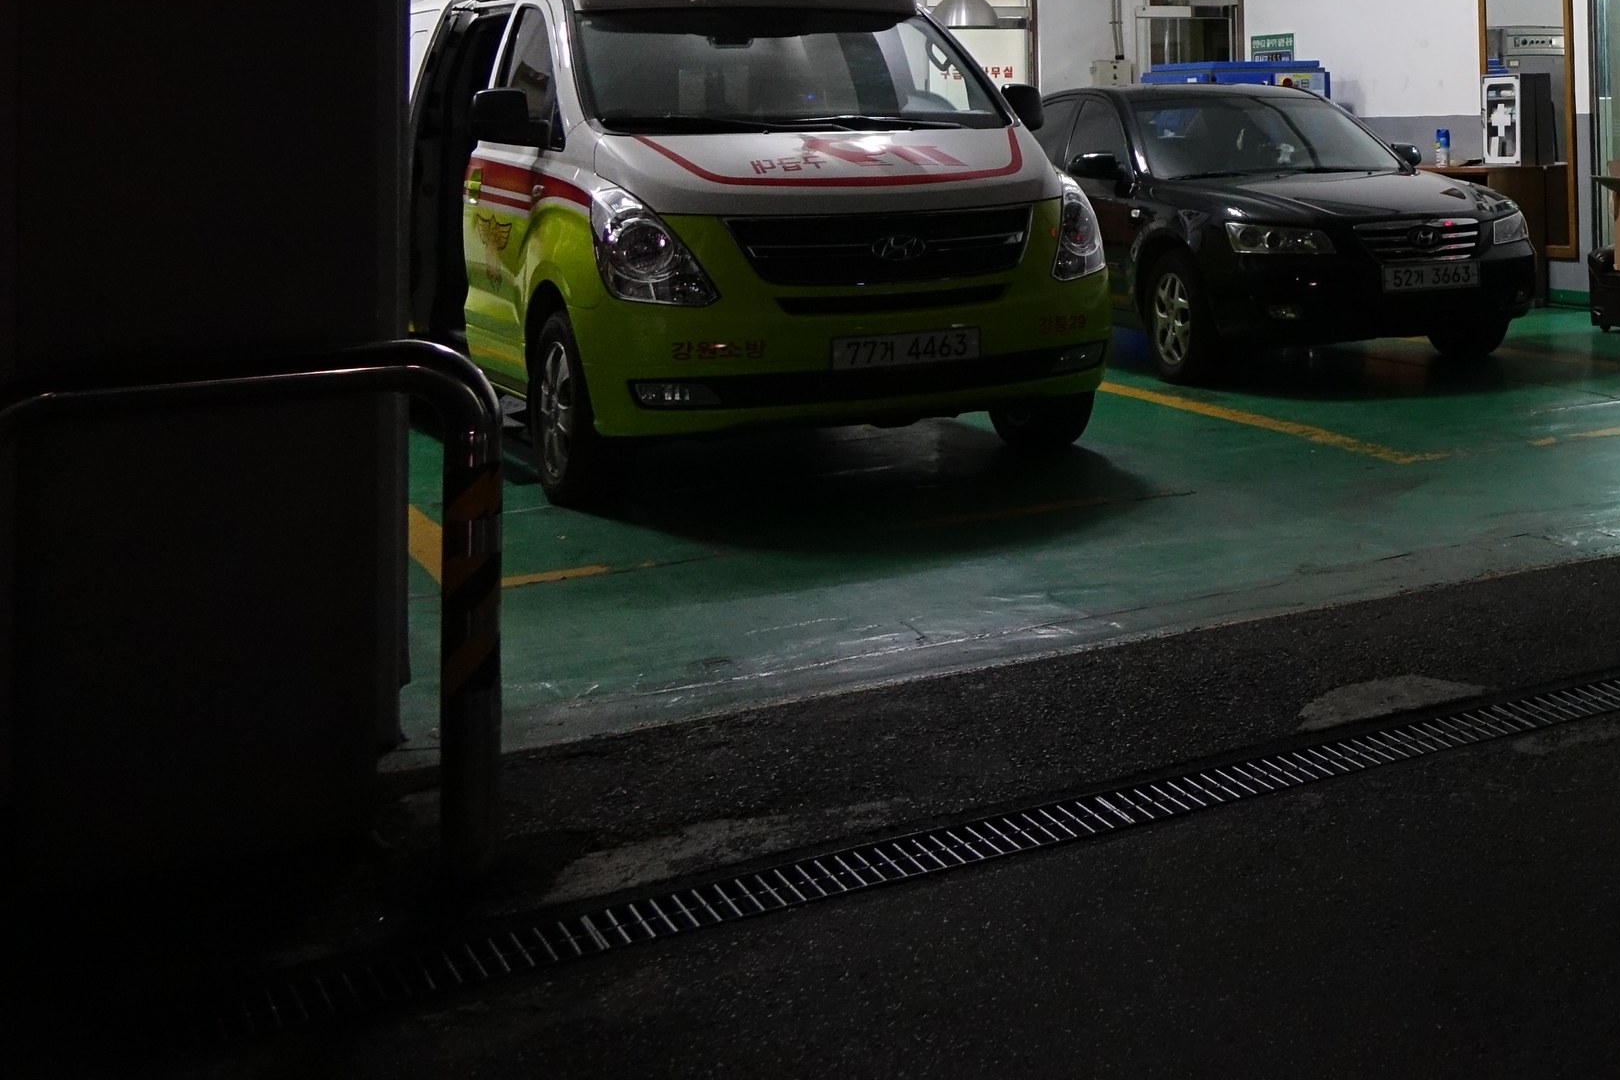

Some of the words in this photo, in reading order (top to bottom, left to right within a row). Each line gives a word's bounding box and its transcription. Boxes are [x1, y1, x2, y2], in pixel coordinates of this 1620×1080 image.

[1431, 265, 1471, 285] 3663
[672, 339, 768, 361] 강원소방
[846, 340, 895, 366] 77거
[906, 333, 968, 359] 4463
